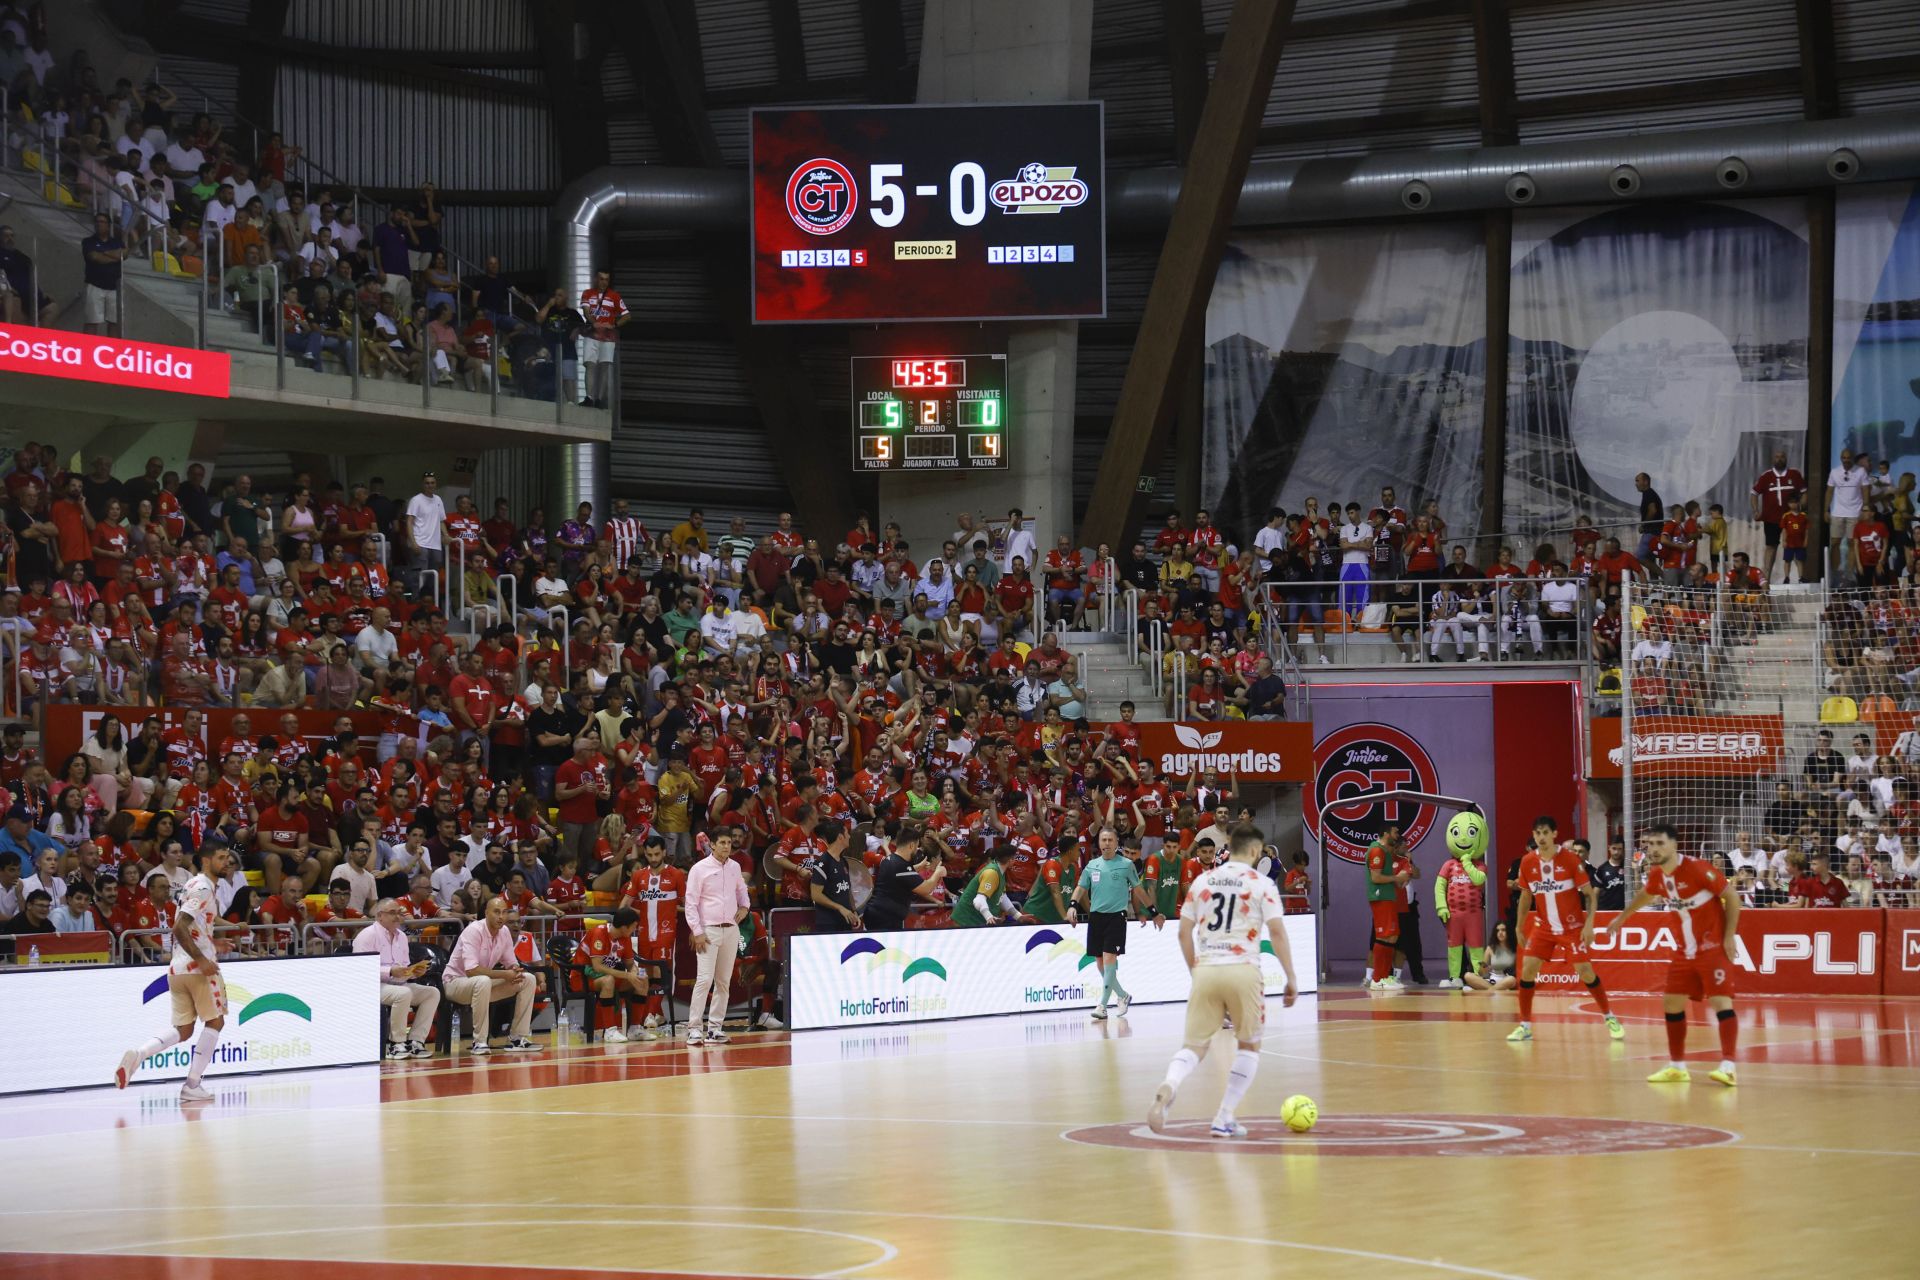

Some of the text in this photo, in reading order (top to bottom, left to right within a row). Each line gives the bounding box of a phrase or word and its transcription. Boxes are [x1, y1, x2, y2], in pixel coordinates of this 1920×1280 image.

[798, 183, 844, 212] CT
[869, 163, 905, 228] 5
[949, 161, 986, 227] 0
[803, 253, 811, 264] 2
[821, 253, 829, 264] 3
[837, 252, 846, 264] 4
[855, 252, 864, 263] 5
[897, 244, 953, 255] PERIODO: 2
[1010, 249, 1018, 260] 2
[1027, 249, 1035, 260] 3
[1044, 248, 1053, 260] 4
[93, 345, 193, 379] Cálida
[867, 391, 895, 400] LOCAL
[957, 390, 1000, 399] VISITANTE
[885, 401, 899, 427] 5
[924, 402, 935, 423] 2
[982, 400, 996, 426] 0
[914, 425, 945, 433] PERIODO
[877, 436, 889, 458] 5
[985, 436, 997, 456] 4
[864, 460, 889, 468] FALTAS
[937, 459, 959, 467] FALTAS
[1632, 731, 1762, 753] MASEGO
[1161, 749, 1281, 776] agriverdes
[1343, 746, 1389, 766] Jimbee
[1325, 769, 1412, 821] CT
[1342, 826, 1379, 841] CARTAG
[640, 888, 668, 900] Jimbee
[1531, 878, 1564, 893] Jimbee
[1207, 892, 1236, 934] 31
[1590, 927, 1678, 951] ODA
[1535, 971, 1580, 983] komovil
[1714, 969, 1725, 985] 9
